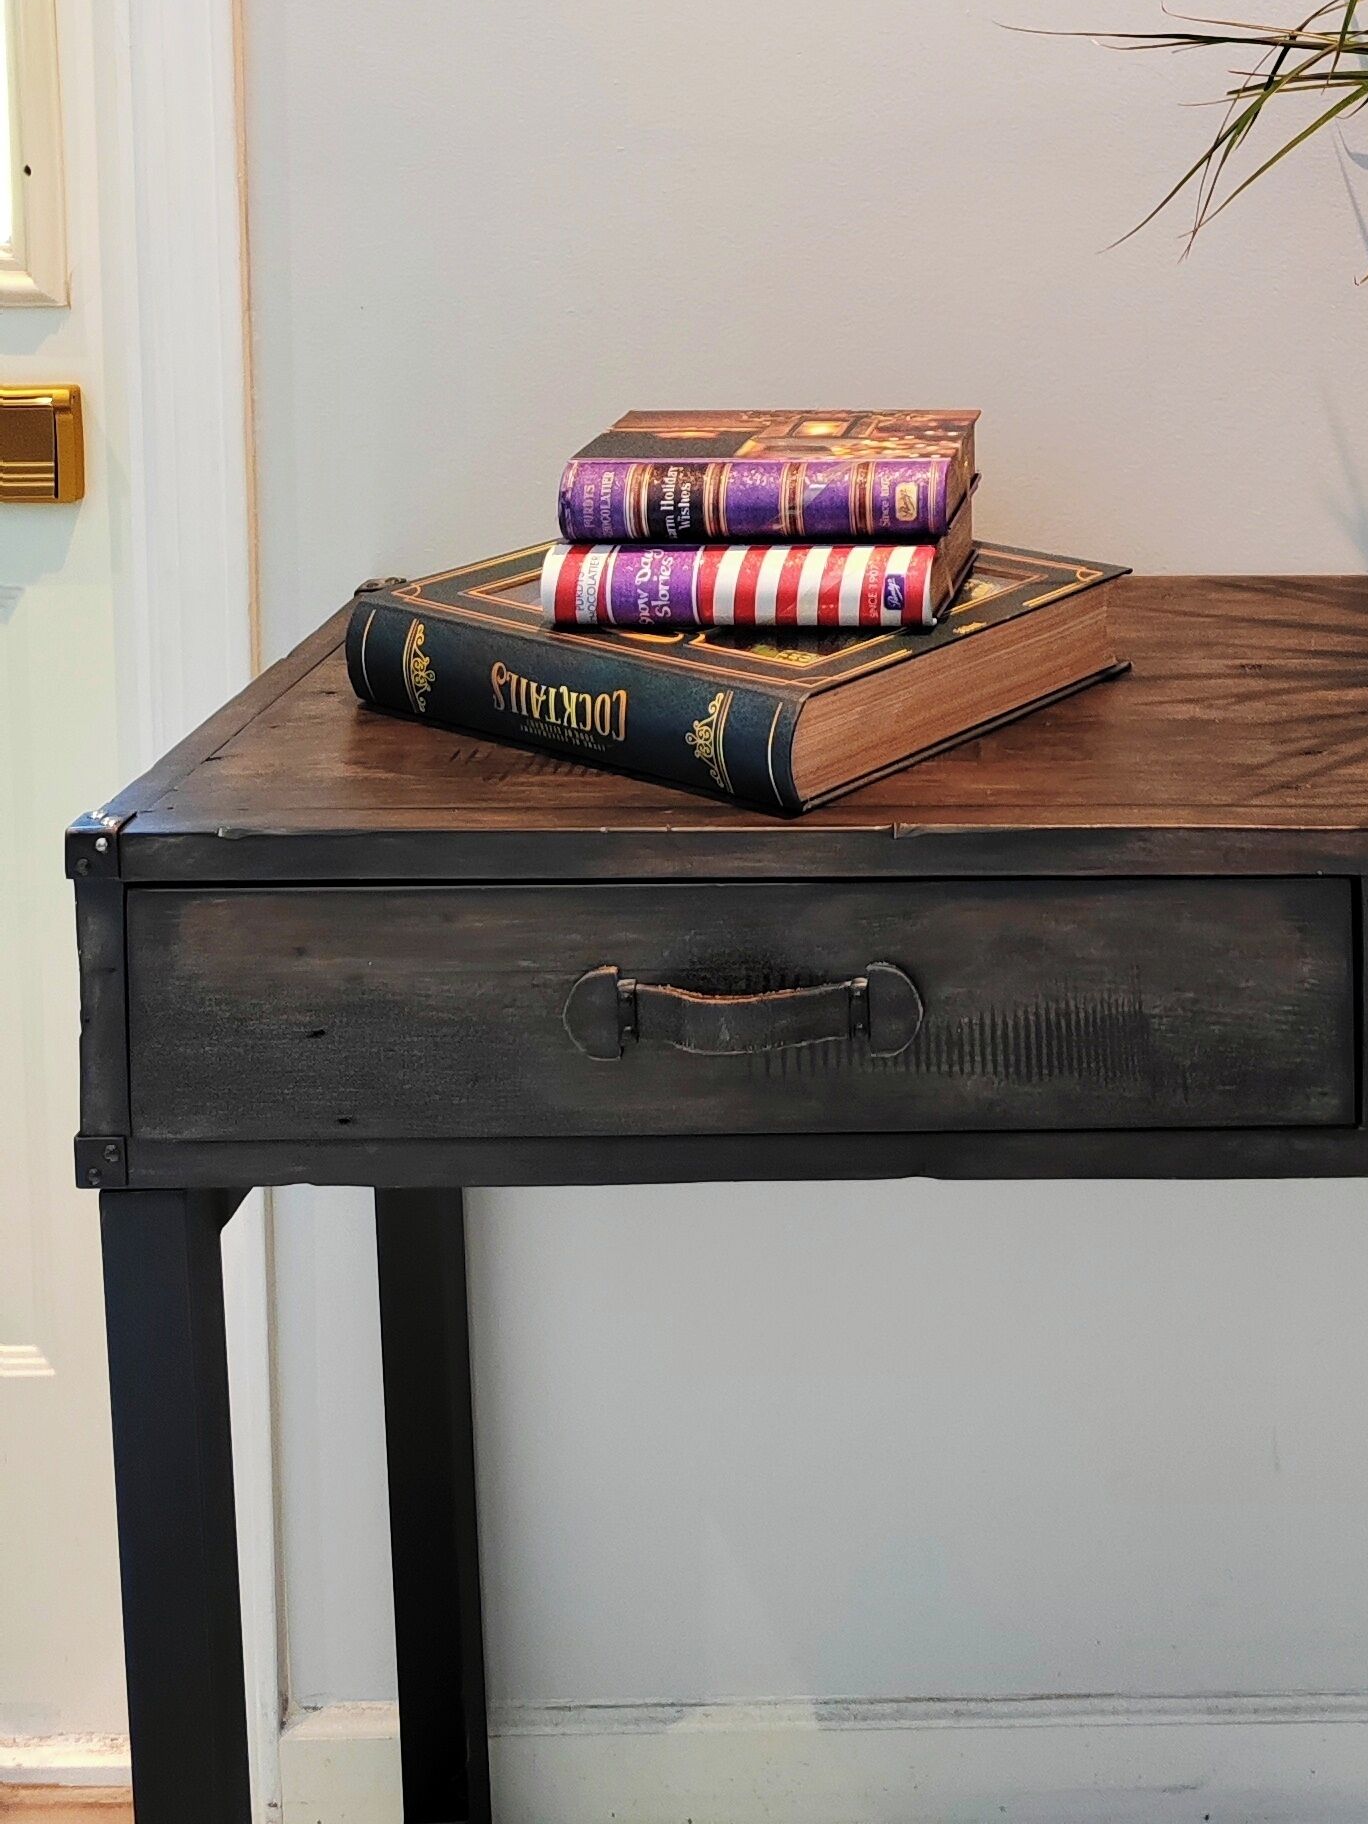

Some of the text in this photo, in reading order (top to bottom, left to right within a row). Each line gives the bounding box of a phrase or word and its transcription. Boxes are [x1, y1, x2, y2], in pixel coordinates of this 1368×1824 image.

[660, 465, 683, 511] Holiday
[678, 482, 692, 531] Wishes
[635, 548, 665, 585] Day
[650, 556, 674, 618] Stories
[491, 661, 627, 742] COCKTAILS
